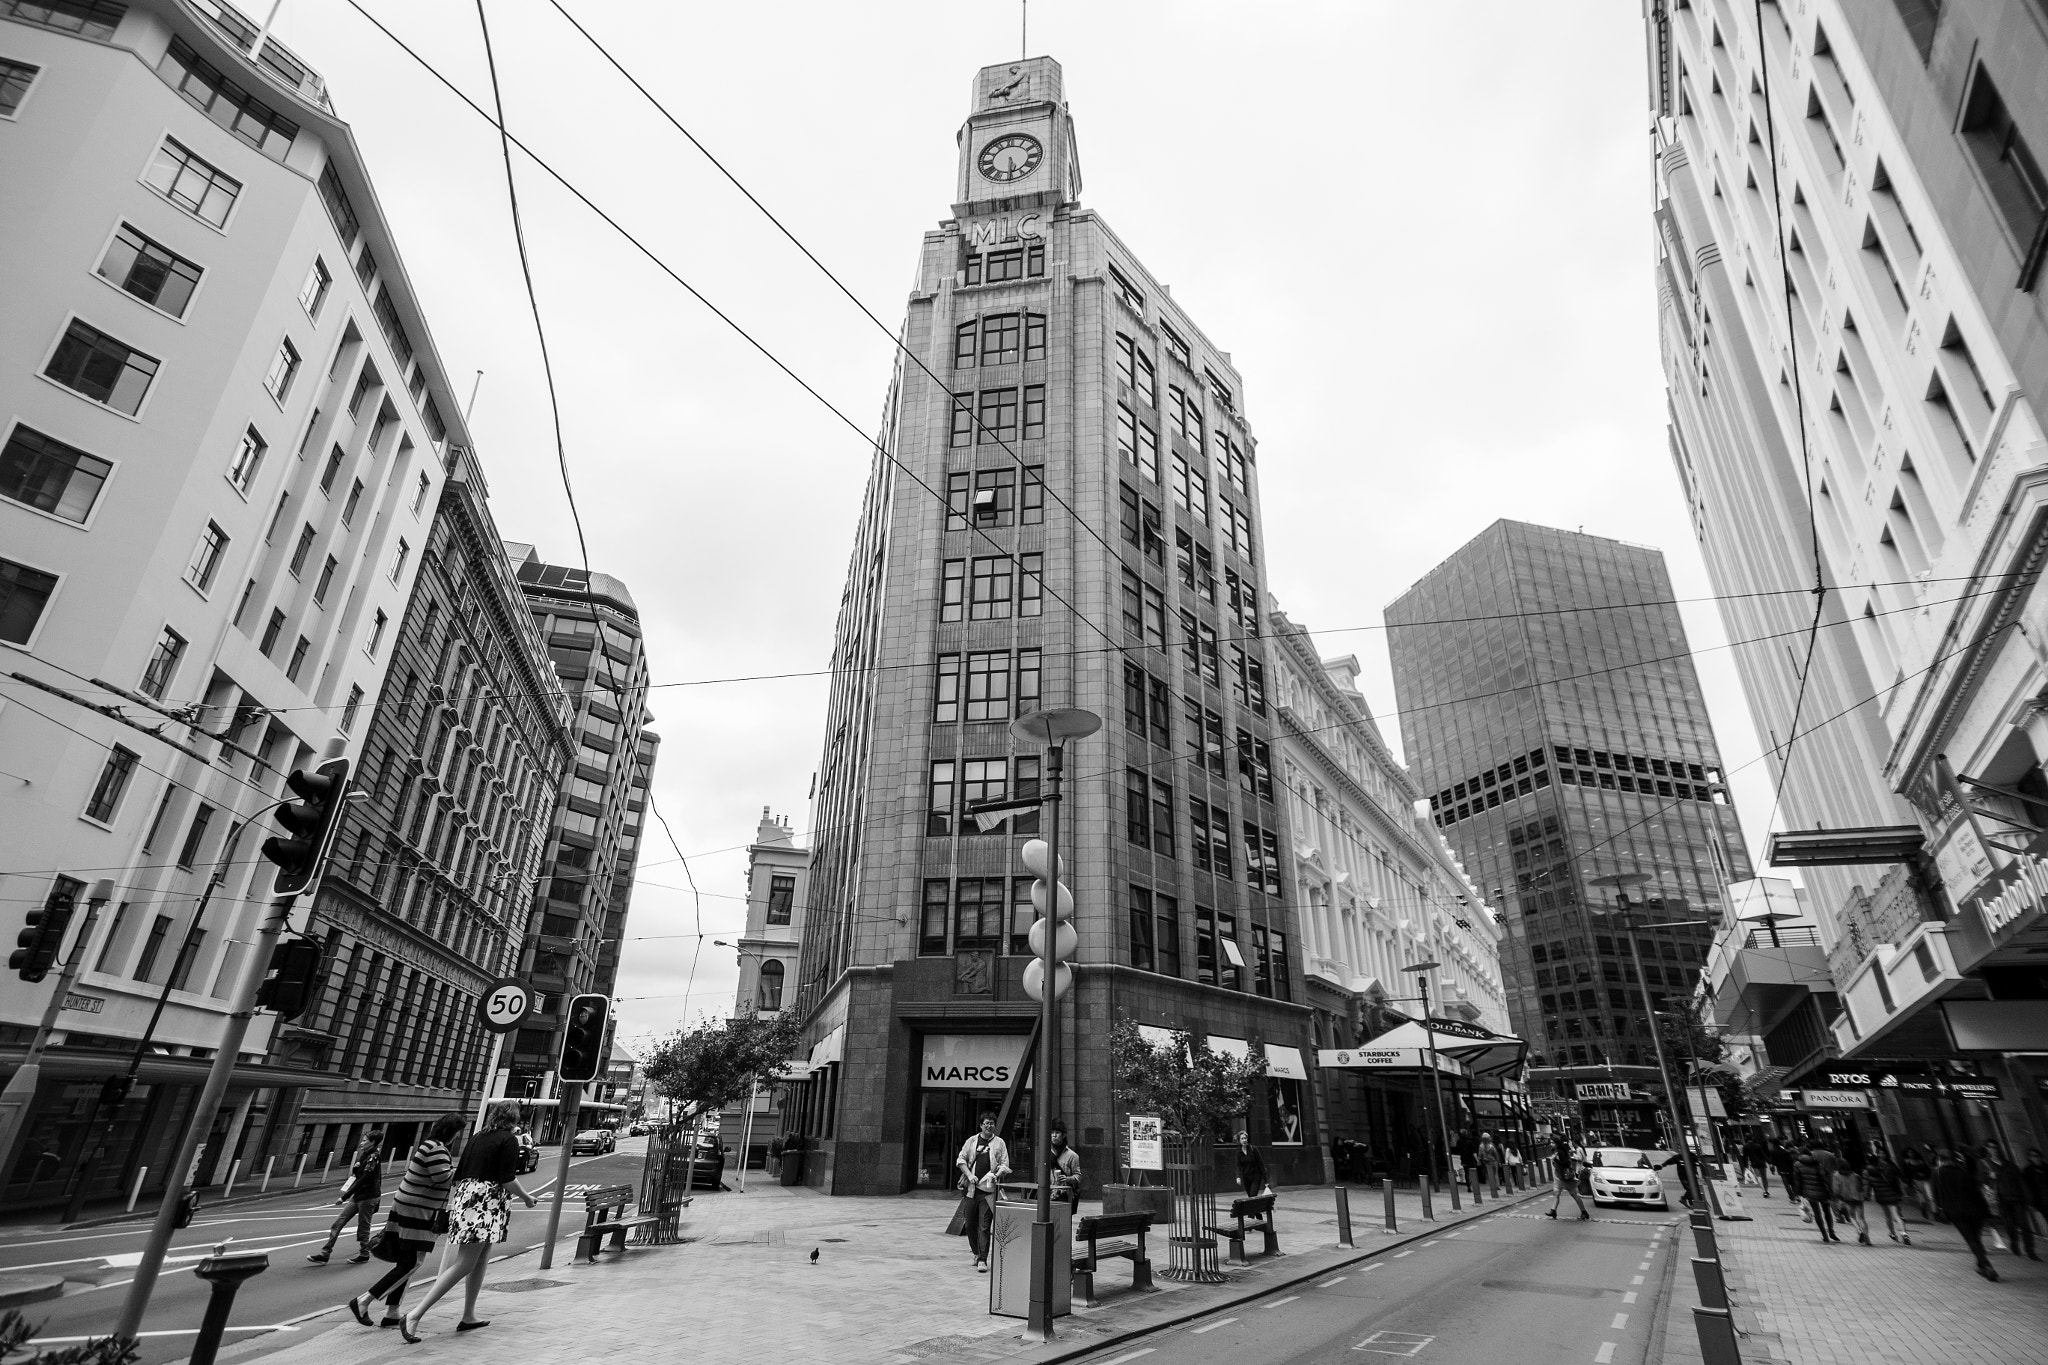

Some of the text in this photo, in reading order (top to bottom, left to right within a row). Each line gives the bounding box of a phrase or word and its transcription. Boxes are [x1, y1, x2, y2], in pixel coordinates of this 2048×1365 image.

[971, 213, 1041, 247] MLC
[65, 995, 101, 1011] HUNTER ST
[491, 994, 524, 1015] 50
[1430, 1022, 1453, 1030] OLD
[1454, 1027, 1486, 1038] BANK
[927, 1066, 1009, 1081] MARCS
[1273, 1066, 1290, 1074] MARCS
[1579, 1085, 1596, 1097] JB
[1810, 1093, 1862, 1104] PANDORA
